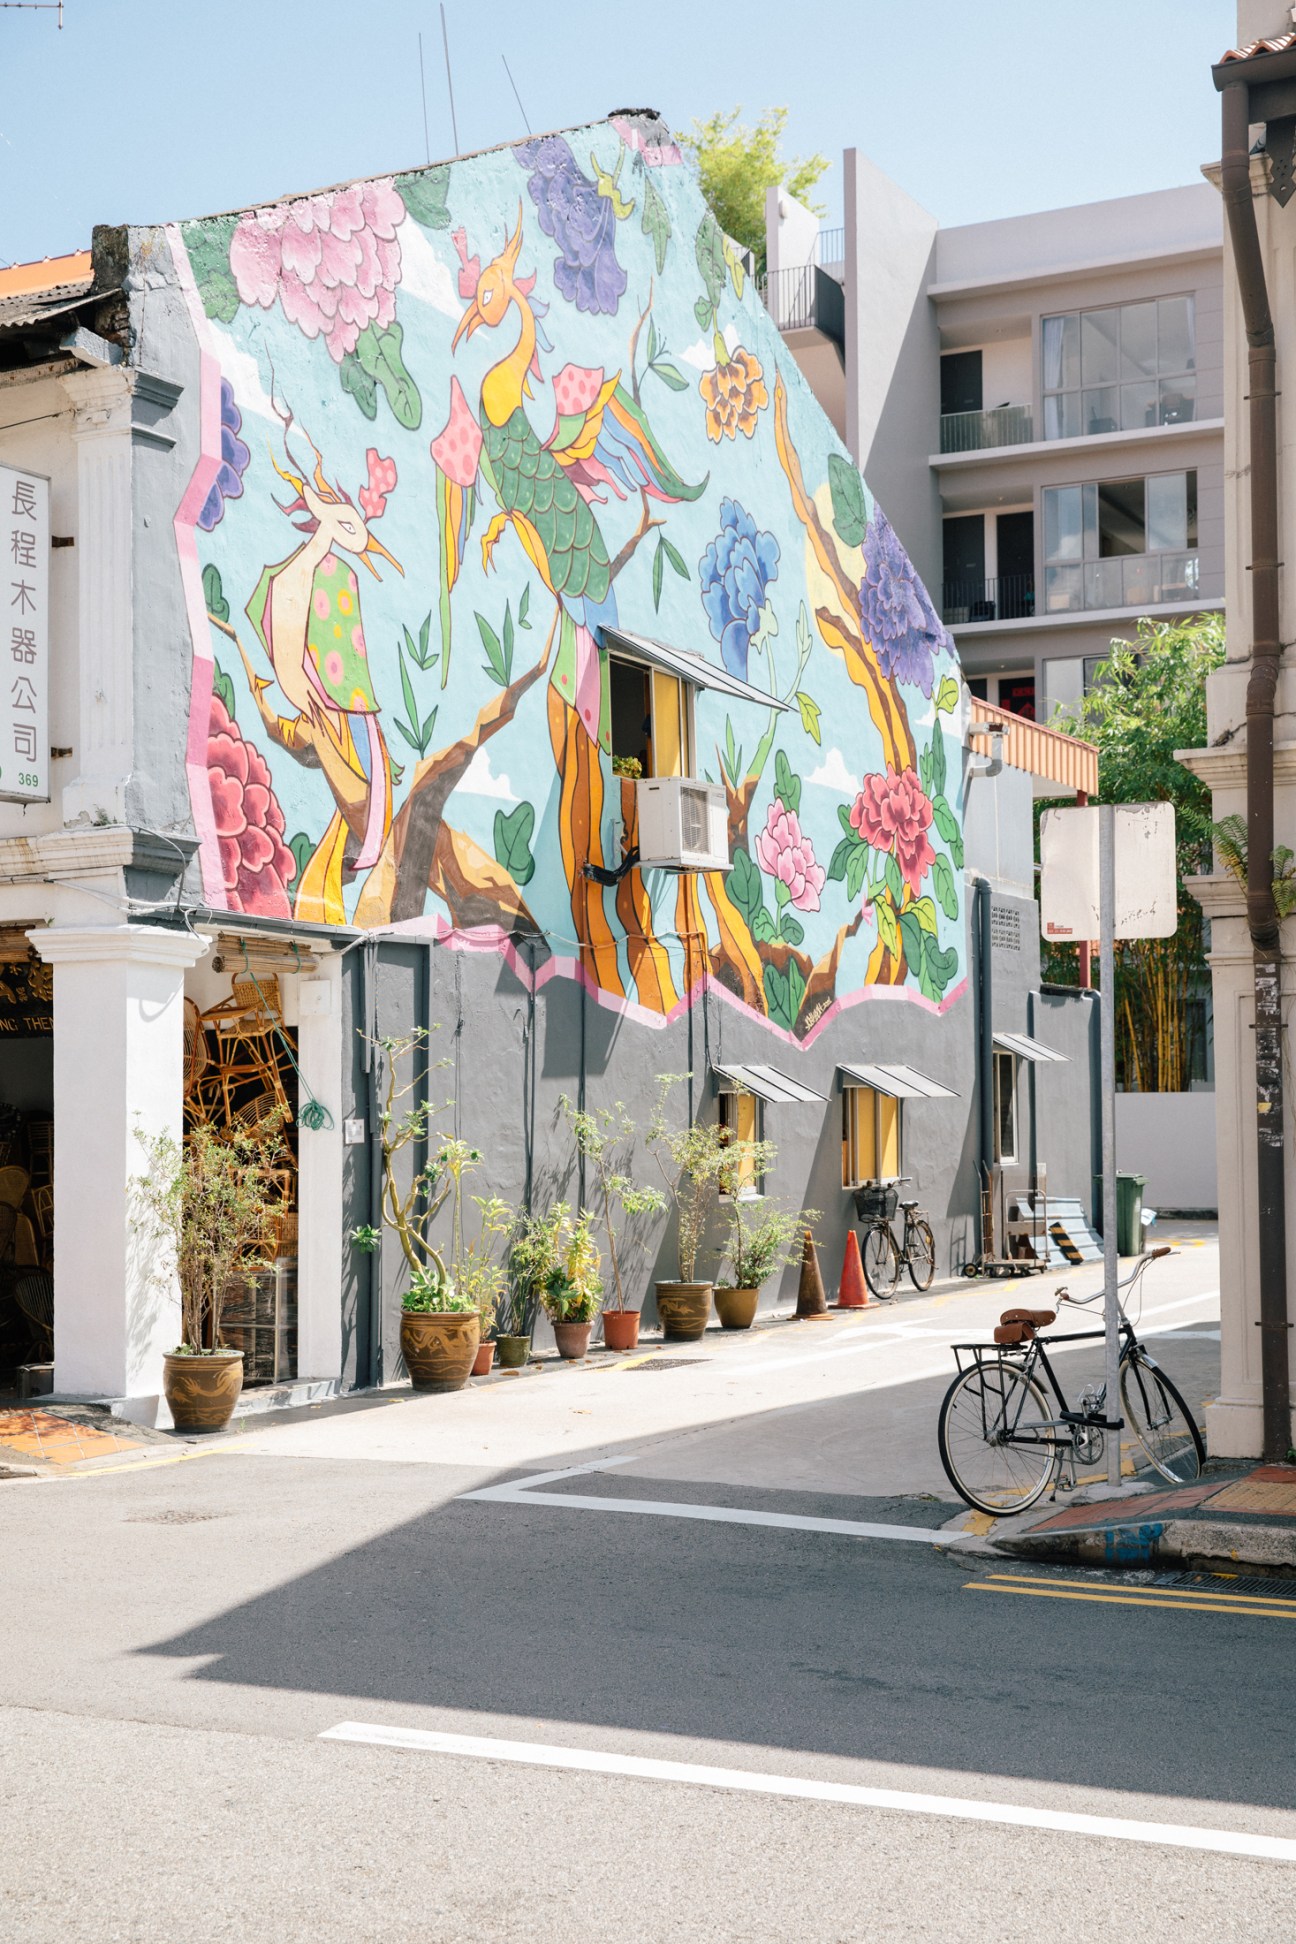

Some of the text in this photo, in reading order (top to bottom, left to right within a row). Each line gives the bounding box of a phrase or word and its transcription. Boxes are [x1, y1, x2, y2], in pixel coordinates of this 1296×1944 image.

[11, 481, 37, 762] 長程木器公司
[19, 773, 39, 787] 369
